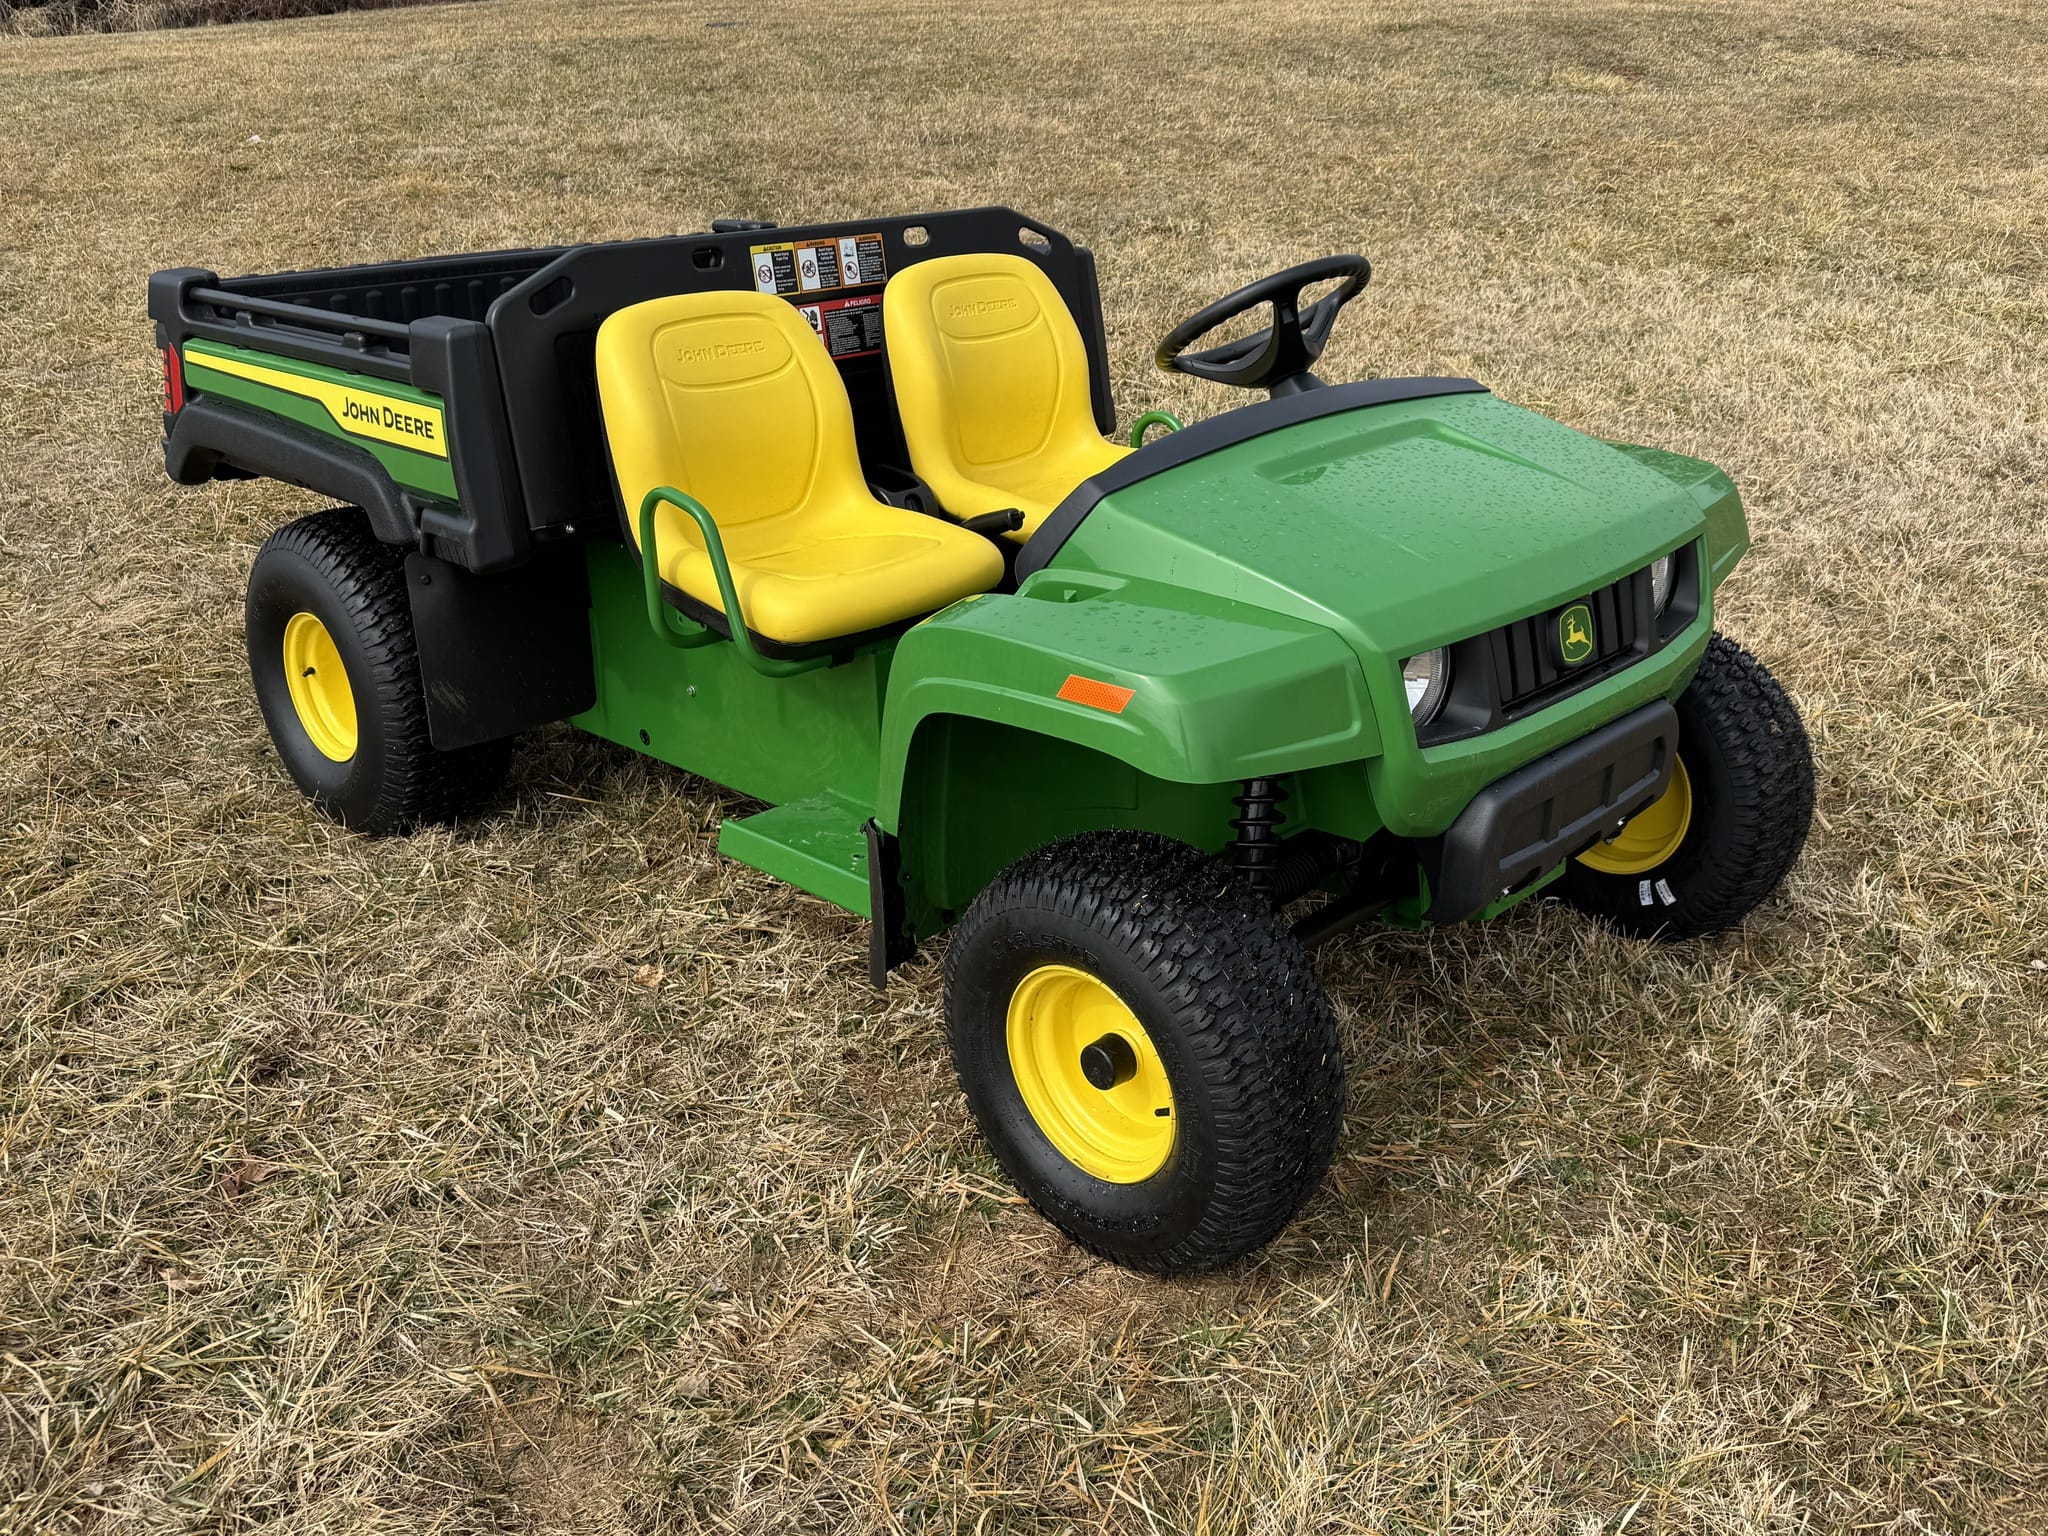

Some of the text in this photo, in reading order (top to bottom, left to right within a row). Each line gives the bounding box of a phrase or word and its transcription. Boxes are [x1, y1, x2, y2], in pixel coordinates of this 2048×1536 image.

[950, 297, 1017, 318] JOHN DEERE
[677, 340, 766, 364] JOHN DEERE
[342, 396, 435, 440] JOHN DEERE
